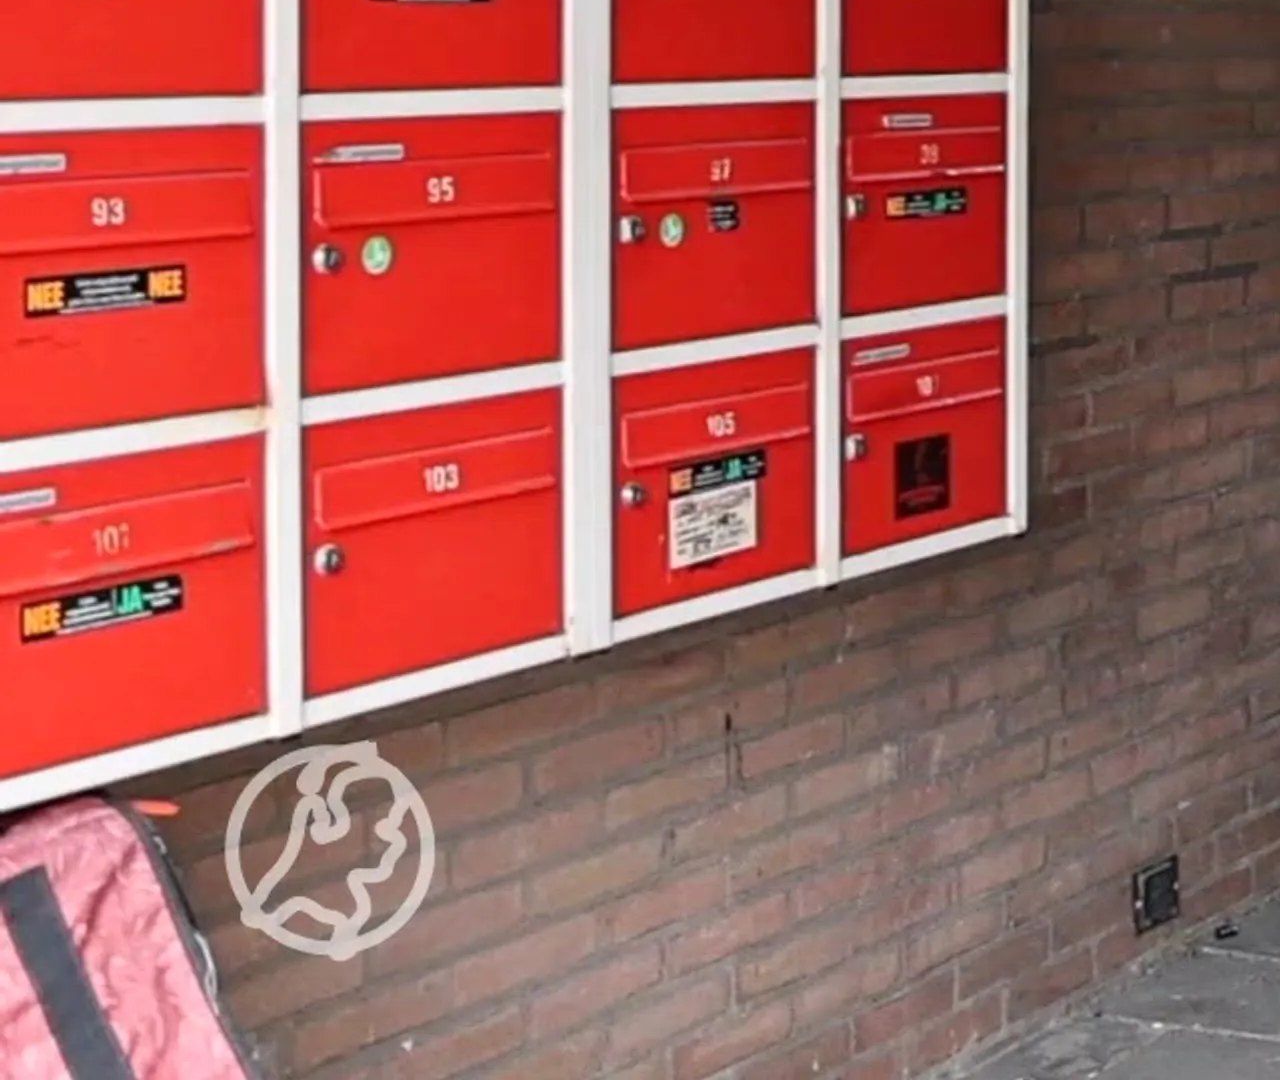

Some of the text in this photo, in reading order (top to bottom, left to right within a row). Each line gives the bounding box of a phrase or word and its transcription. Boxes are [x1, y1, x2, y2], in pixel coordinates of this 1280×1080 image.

[426, 175, 455, 203] 95
[90, 196, 126, 227] 93
[706, 411, 737, 437] 105
[423, 463, 460, 493] 103
[116, 584, 145, 615] JA
